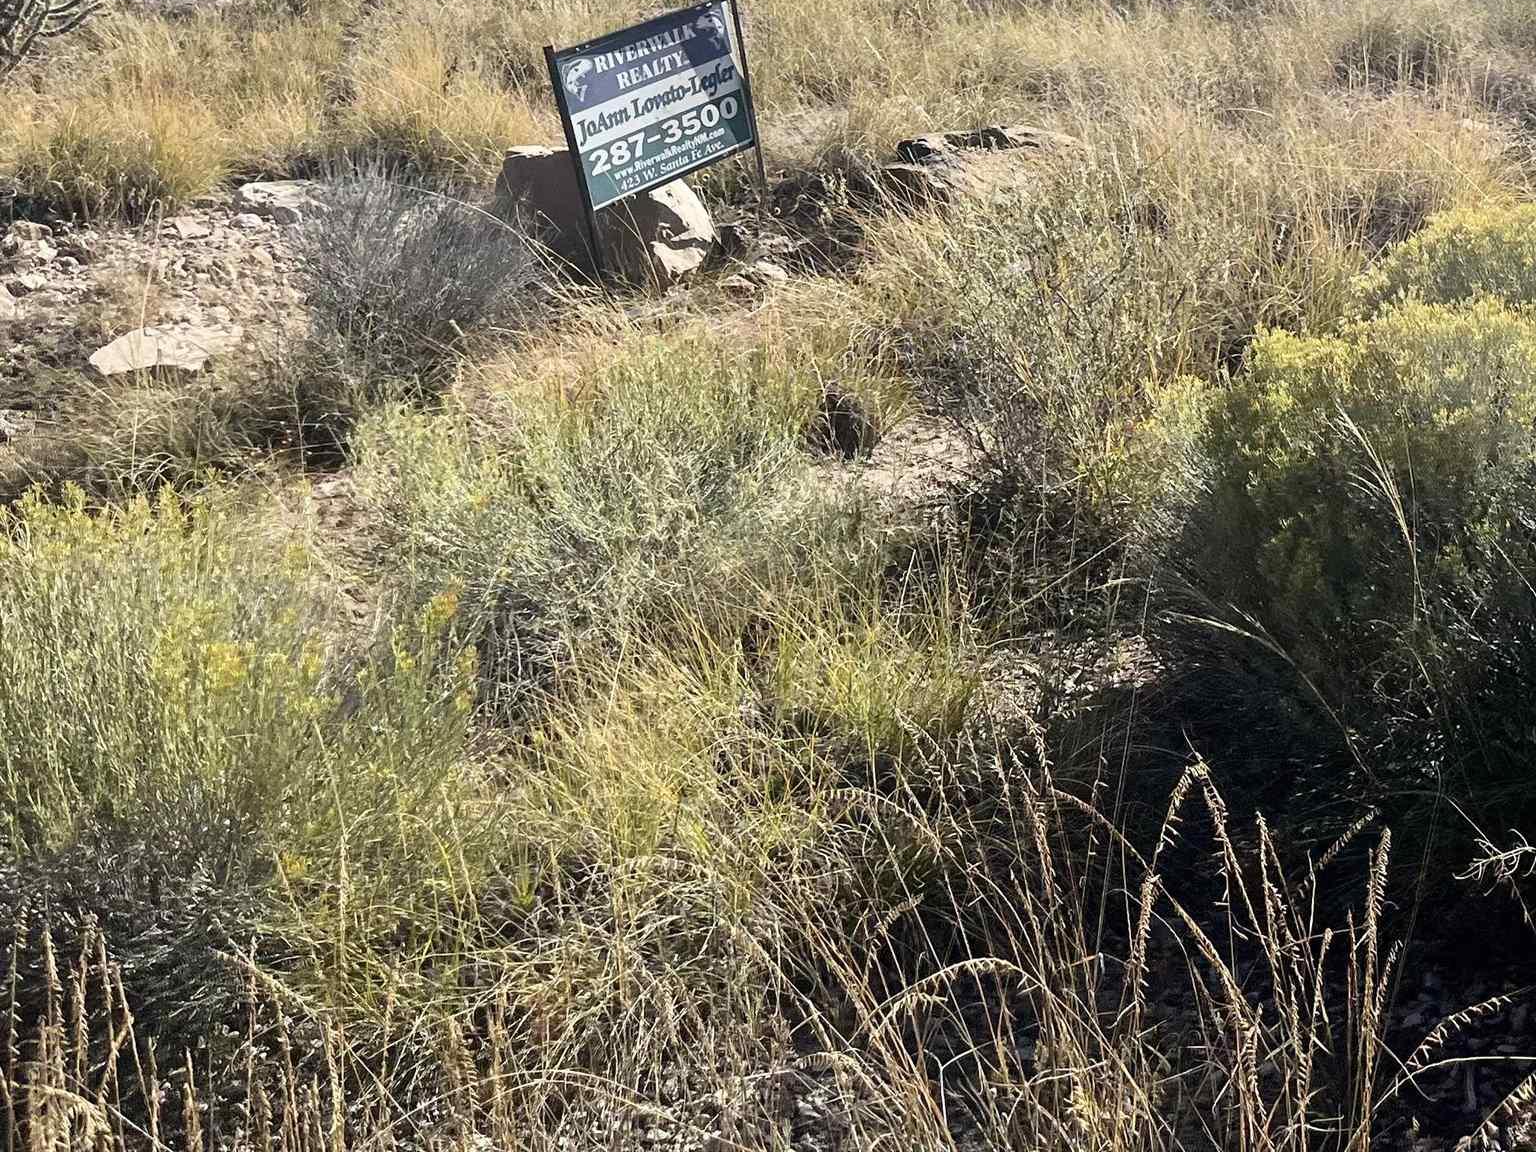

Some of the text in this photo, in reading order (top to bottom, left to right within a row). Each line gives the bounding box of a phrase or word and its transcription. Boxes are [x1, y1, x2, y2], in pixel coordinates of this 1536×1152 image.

[594, 22, 696, 74] RIVERWALK
[576, 62, 735, 147] JoAnn Lovato-Legler
[588, 96, 738, 177] 287-3500
[620, 176, 641, 192] 423
[643, 167, 658, 181] W.
[660, 155, 690, 176] Santa
[704, 140, 725, 157] Ave.
